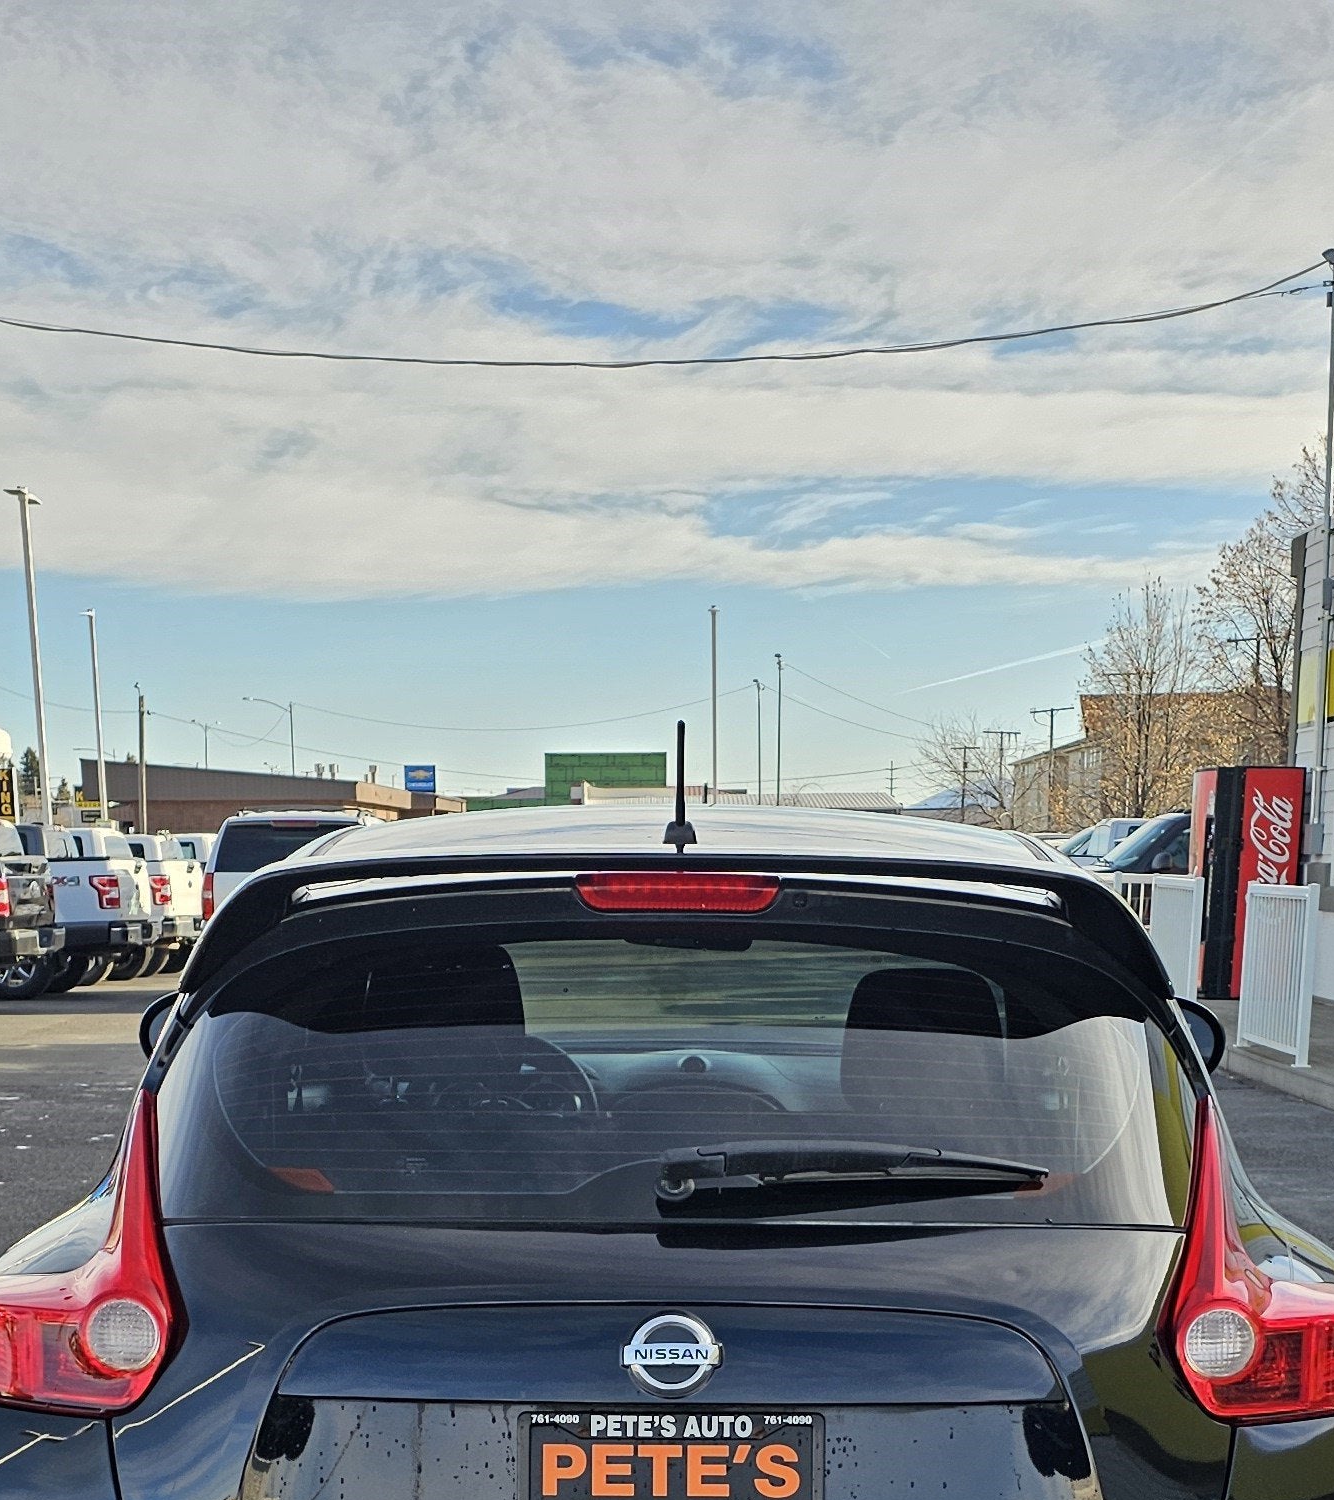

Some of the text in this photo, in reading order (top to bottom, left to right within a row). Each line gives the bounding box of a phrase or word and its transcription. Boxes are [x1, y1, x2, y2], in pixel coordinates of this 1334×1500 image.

[633, 1348, 709, 1360] NISSAN
[530, 1414, 580, 1424] 761-4090
[763, 1415, 813, 1425] 761-4090
[590, 1414, 753, 1438] PETE'S AUTO
[542, 1443, 801, 1498] PETE'S
